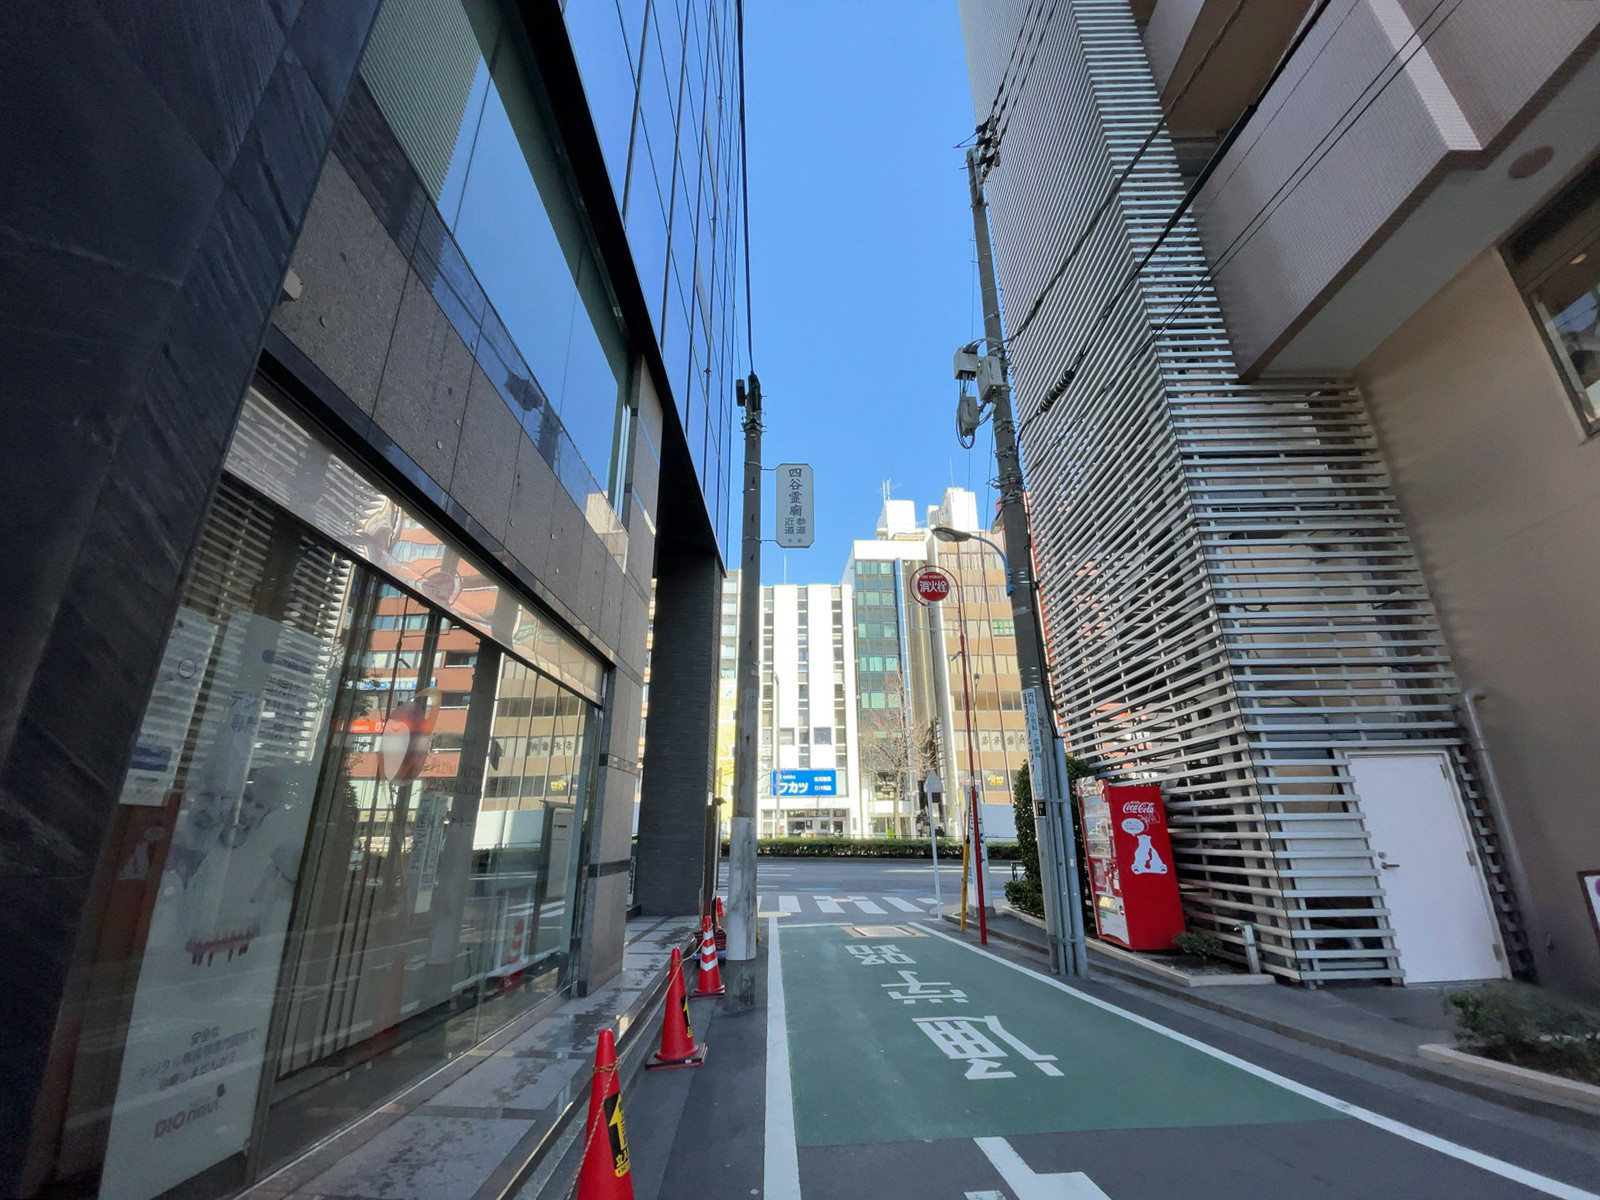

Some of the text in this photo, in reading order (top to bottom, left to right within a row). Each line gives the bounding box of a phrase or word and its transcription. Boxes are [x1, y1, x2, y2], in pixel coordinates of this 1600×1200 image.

[788, 468, 803, 517] 四谷霊廟
[784, 517, 795, 535] 近道
[796, 517, 806, 535] 参道
[919, 580, 947, 593] 消火栓
[845, 944, 1065, 1080] 通学路
